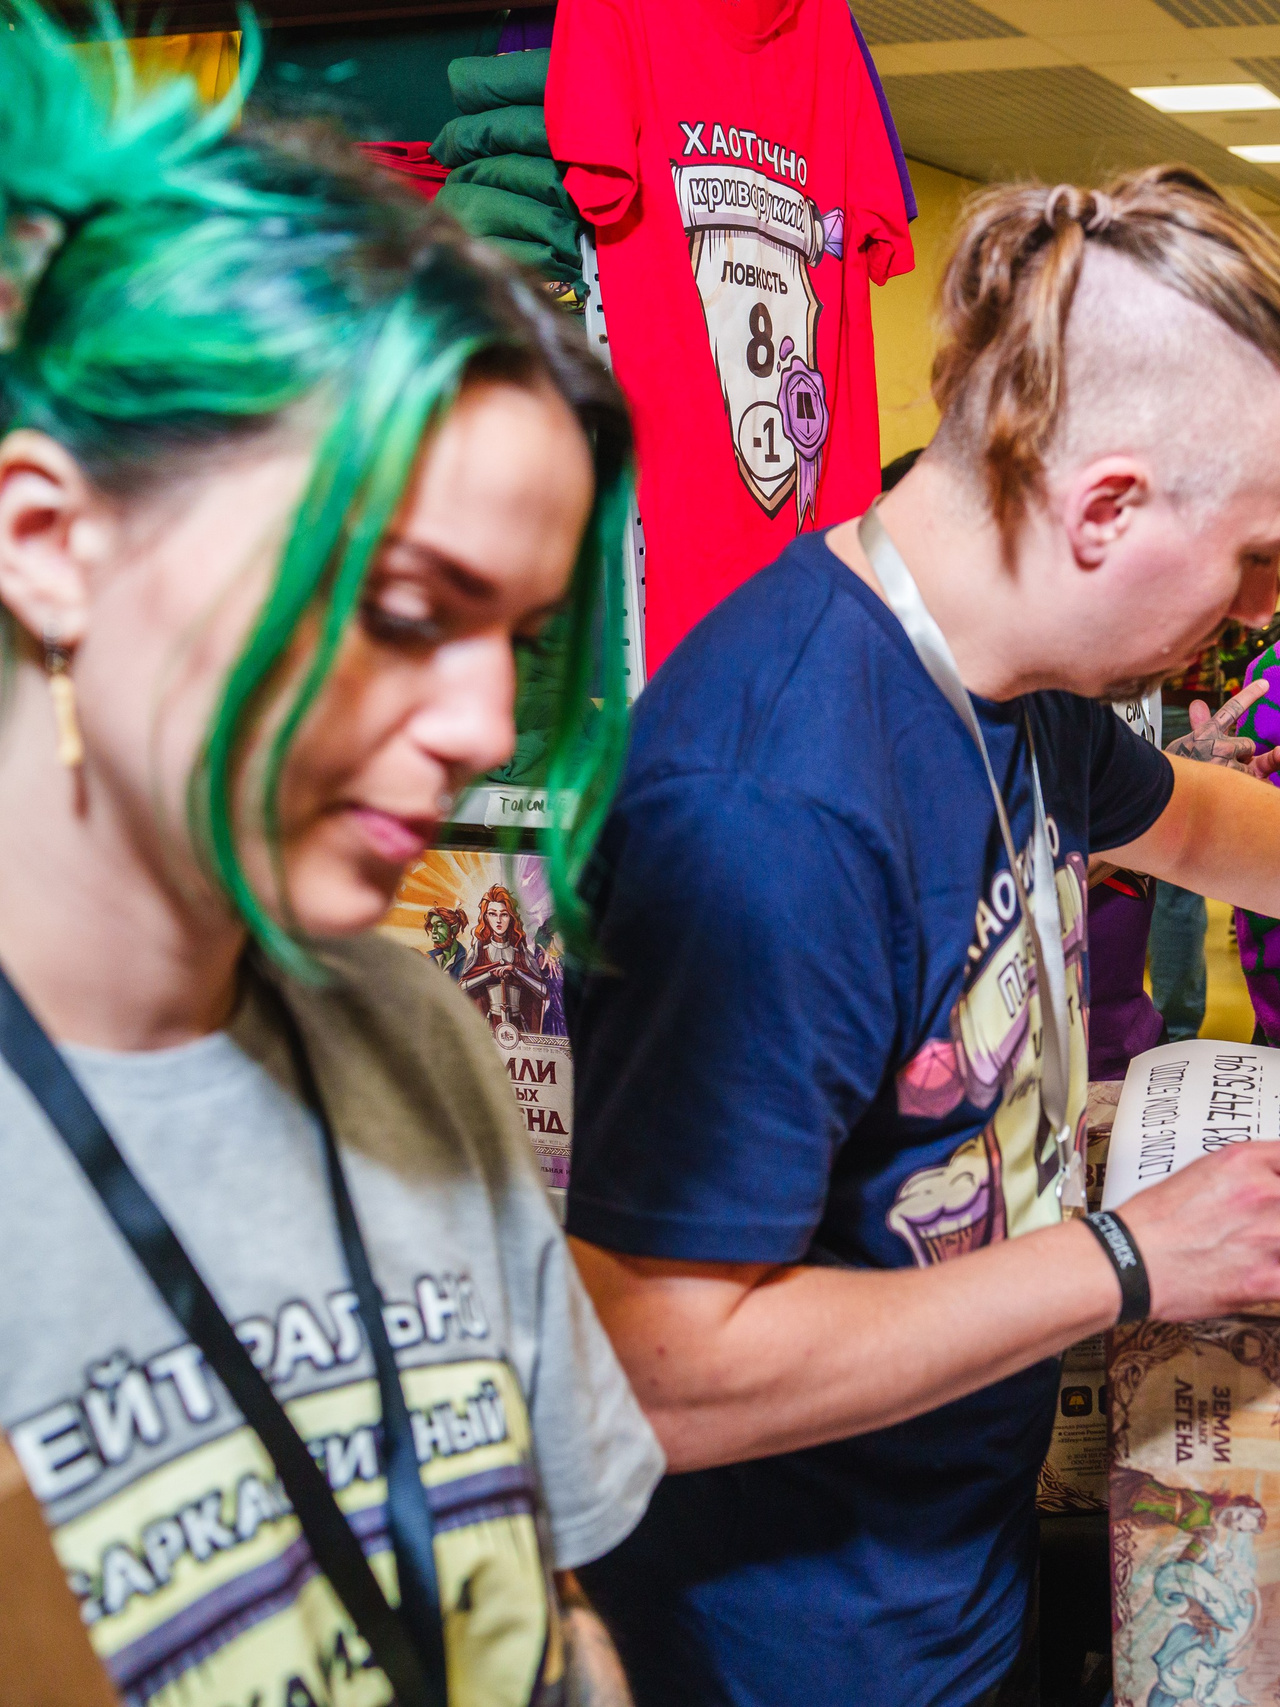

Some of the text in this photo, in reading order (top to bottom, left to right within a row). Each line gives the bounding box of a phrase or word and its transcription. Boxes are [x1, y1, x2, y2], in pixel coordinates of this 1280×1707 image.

[721, 260, 788, 295] ЛОВКОСТЬ
[746, 302, 775, 379] 8
[752, 417, 781, 464] -1
[1147, 1060, 1190, 1096] STUDIO
[1138, 1129, 1177, 1180] LIVING
[1175, 1376, 1194, 1464] ЛЕГЕНД
[1212, 1384, 1231, 1464] ЗЕМЛИ
